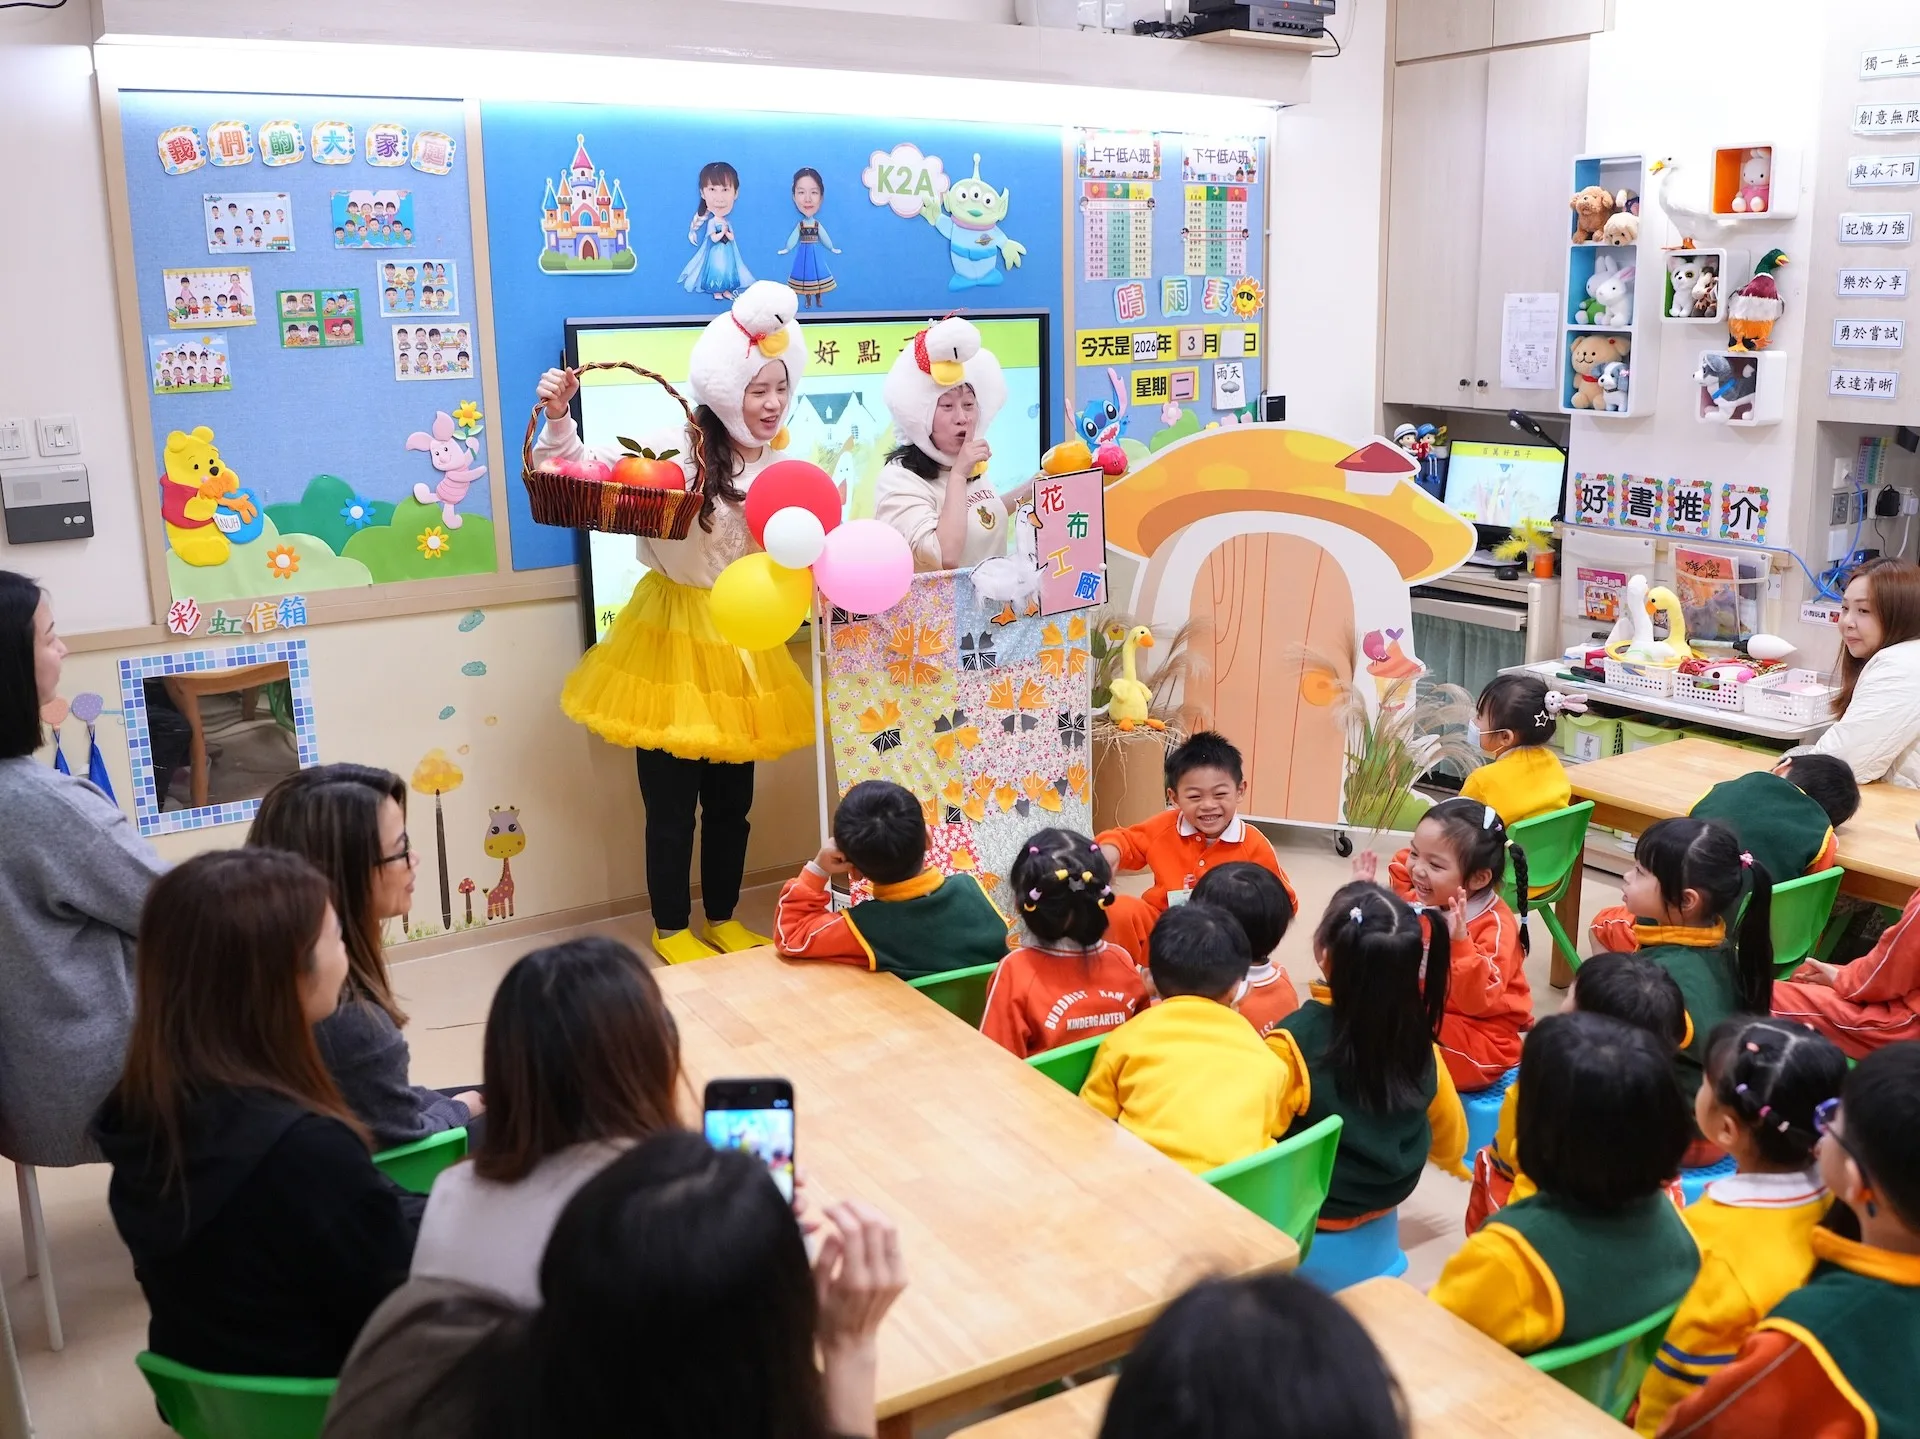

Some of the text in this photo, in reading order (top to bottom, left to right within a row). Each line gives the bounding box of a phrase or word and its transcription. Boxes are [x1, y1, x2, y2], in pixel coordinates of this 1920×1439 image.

[1858, 109, 1920, 125] 創意無限
[165, 130, 448, 167] 我們的大家庭
[1089, 146, 1152, 164] 上午低A班
[1192, 147, 1249, 165] 下午低A班
[1854, 161, 1915, 178] 與眾不同
[877, 164, 935, 197] K2A
[1845, 220, 1906, 236] 記憶力強
[1843, 274, 1902, 290] 樂於分享
[1117, 277, 1230, 320] 晴雨表
[1839, 325, 1899, 341] 勇於嘗試
[813, 336, 915, 366] 好點
[1216, 365, 1241, 381] 雨天
[1136, 376, 1190, 398] 星期二
[1833, 374, 1893, 393] 表達清晰
[1581, 483, 1759, 530] 好書推介
[1040, 484, 1101, 601] 花布工廠
[170, 595, 307, 635] 彩虹信箱
[1044, 989, 1089, 1031] BUDDHIST
[1098, 989, 1124, 1002] KAM
[1066, 1011, 1126, 1031] KINDERGARTEN
